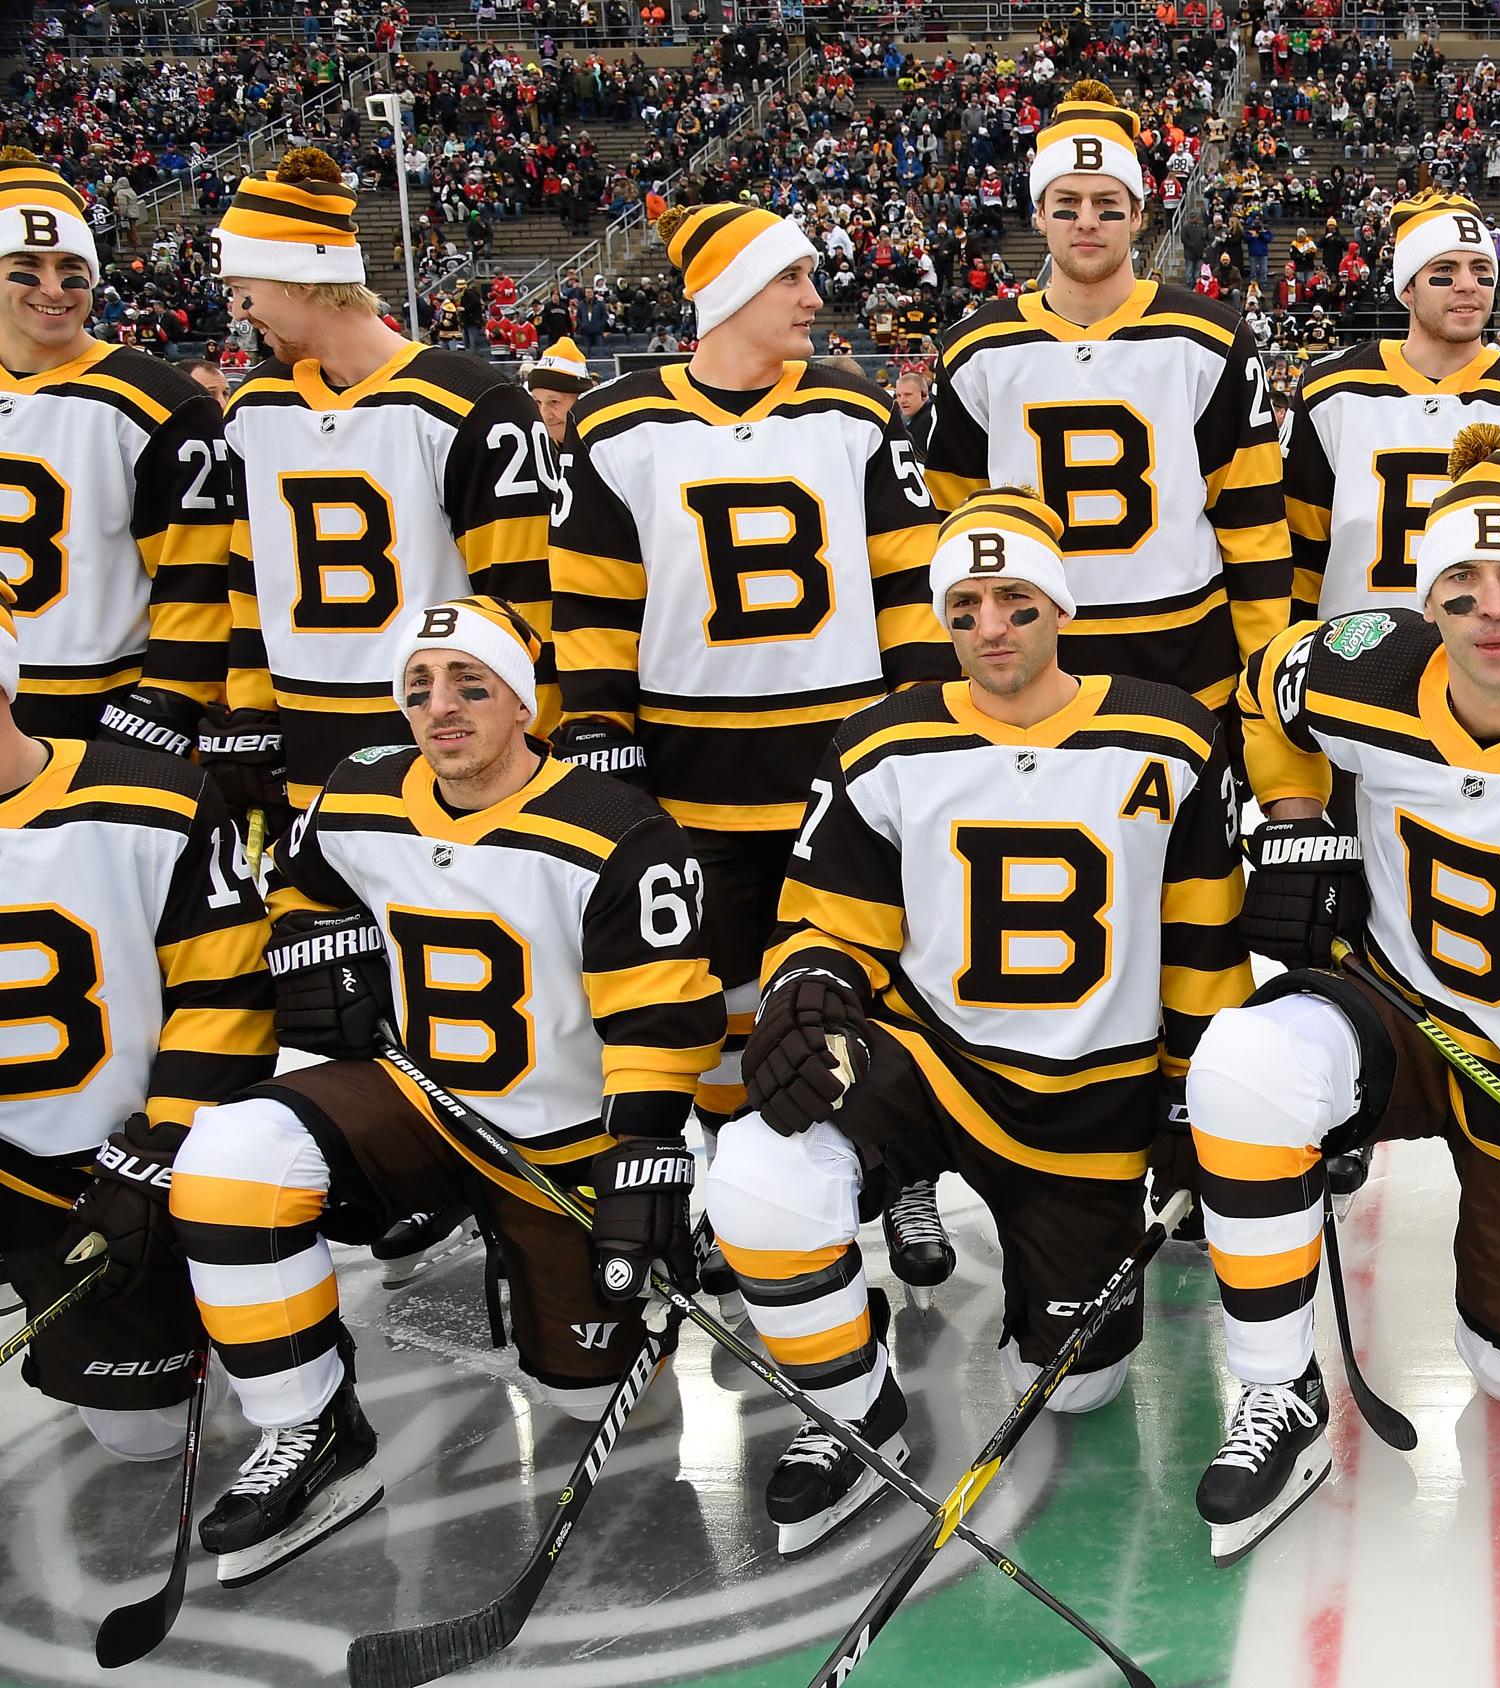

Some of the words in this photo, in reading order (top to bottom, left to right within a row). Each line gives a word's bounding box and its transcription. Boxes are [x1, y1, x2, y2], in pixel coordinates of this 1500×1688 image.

[1073, 138, 1103, 170] B
[20, 210, 58, 246] B
[1453, 216, 1481, 244] B
[1023, 400, 1159, 557] B
[277, 469, 404, 634] B
[681, 476, 837, 648] B
[968, 533, 1005, 573] B
[417, 607, 457, 638] B
[1118, 757, 1175, 824] A
[951, 820, 1114, 1009] B
[270, 926, 384, 977] WARRIO
[386, 901, 536, 1097] B
[475, 1127, 510, 1156] MARCHAND
